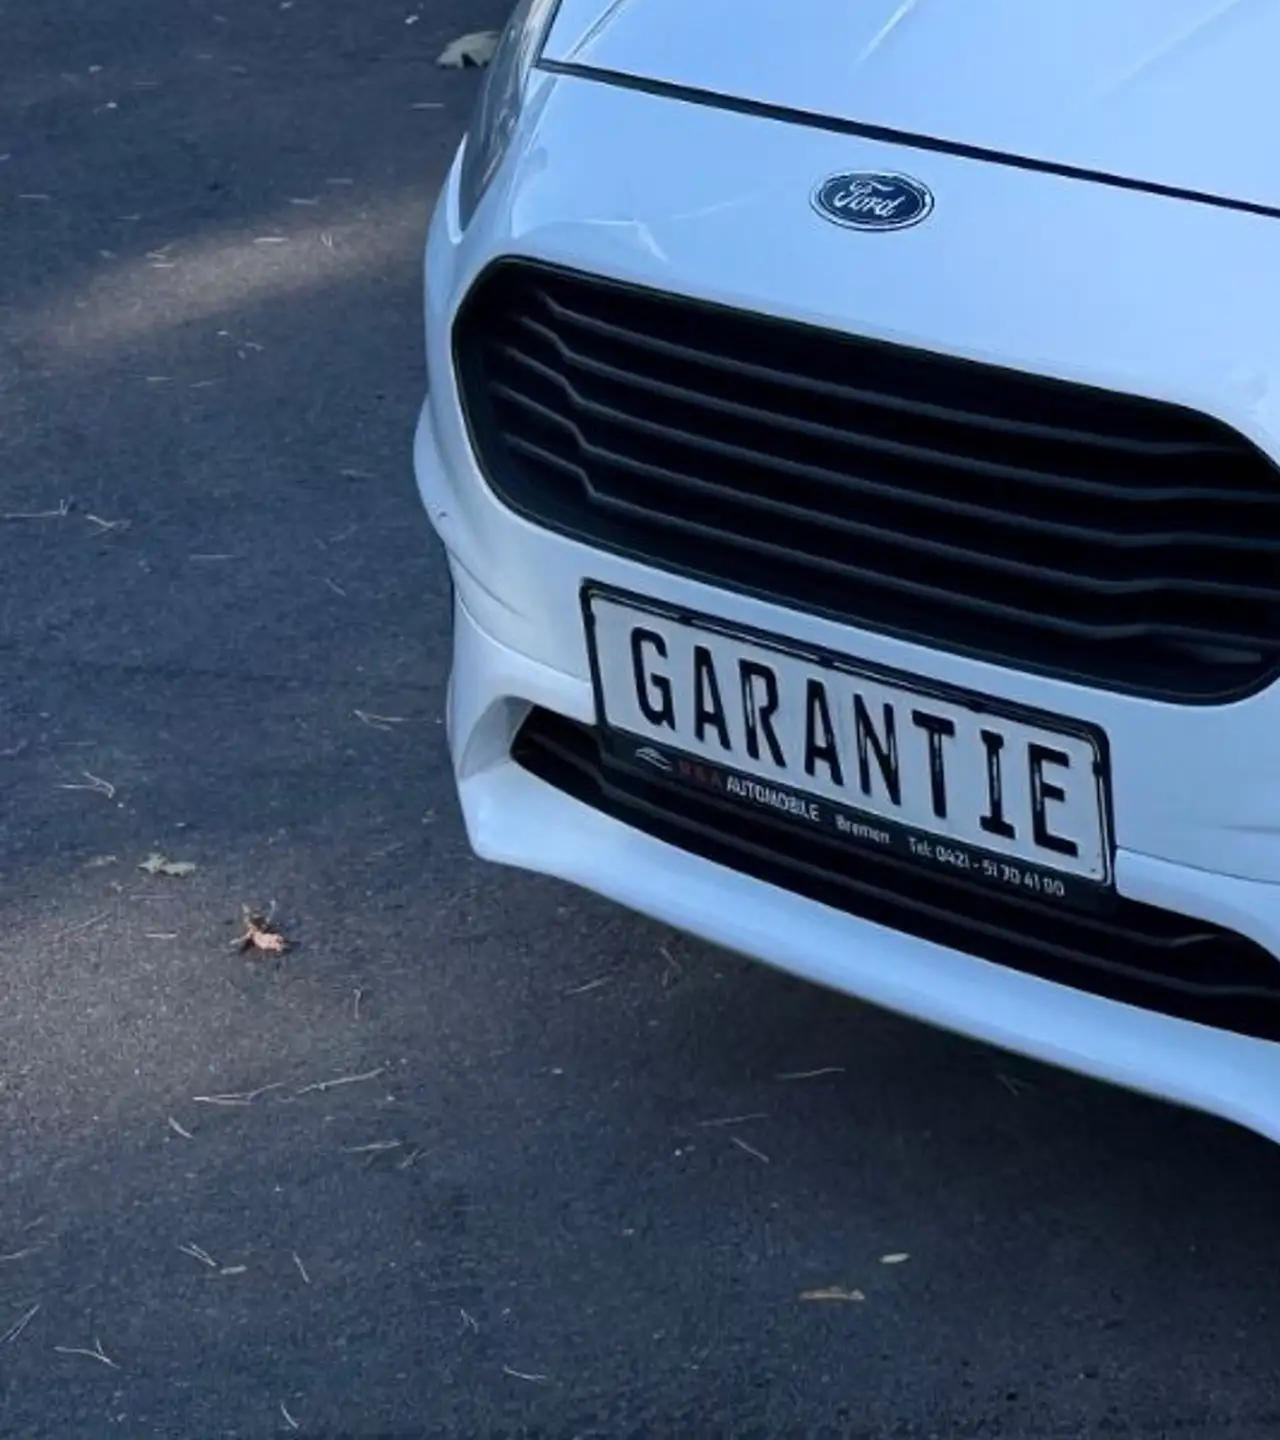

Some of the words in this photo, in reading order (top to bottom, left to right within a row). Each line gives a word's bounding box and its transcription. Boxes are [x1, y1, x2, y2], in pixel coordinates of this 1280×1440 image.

[833, 179, 906, 217] Ford
[630, 626, 1079, 857] GARANTIE
[726, 774, 821, 822] AUTOMOBILE
[834, 813, 890, 844] Bremen
[935, 844, 971, 870] 0421
